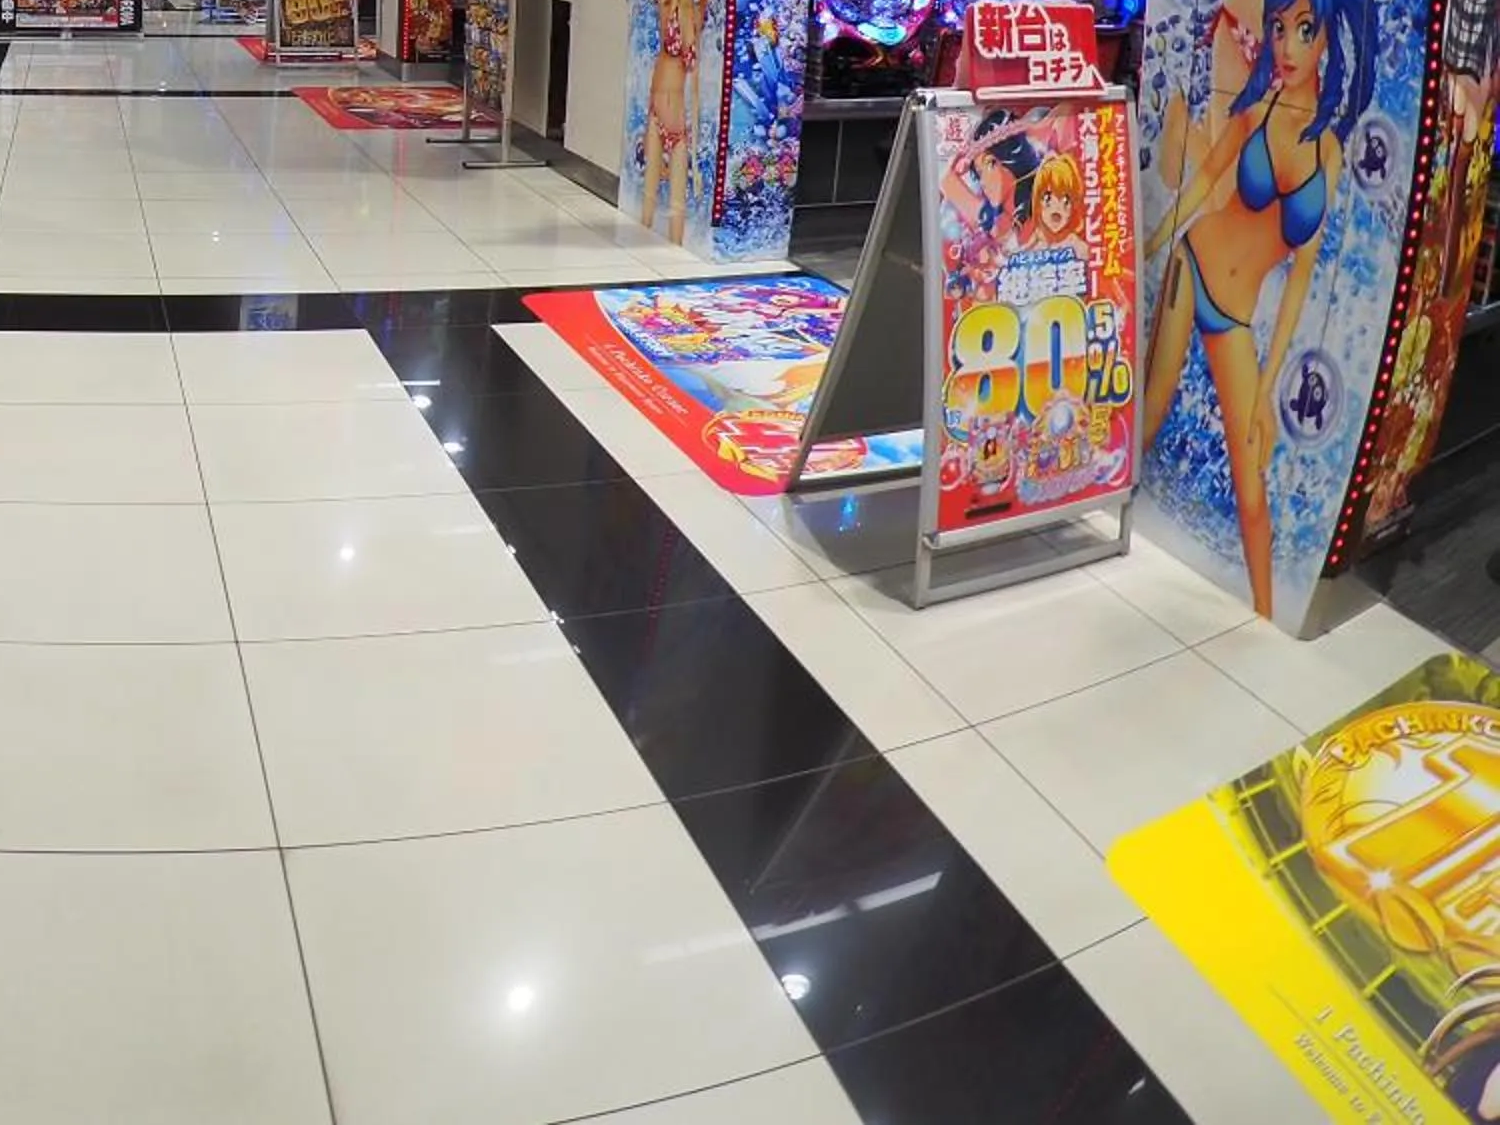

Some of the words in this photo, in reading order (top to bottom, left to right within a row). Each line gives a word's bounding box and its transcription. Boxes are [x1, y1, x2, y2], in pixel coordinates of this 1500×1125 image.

[976, 2, 1068, 57] 新台は
[1030, 54, 1088, 83] コチラ
[1098, 105, 1122, 278] アグネス・ラム
[1293, 1032, 1349, 1095] Welcome
